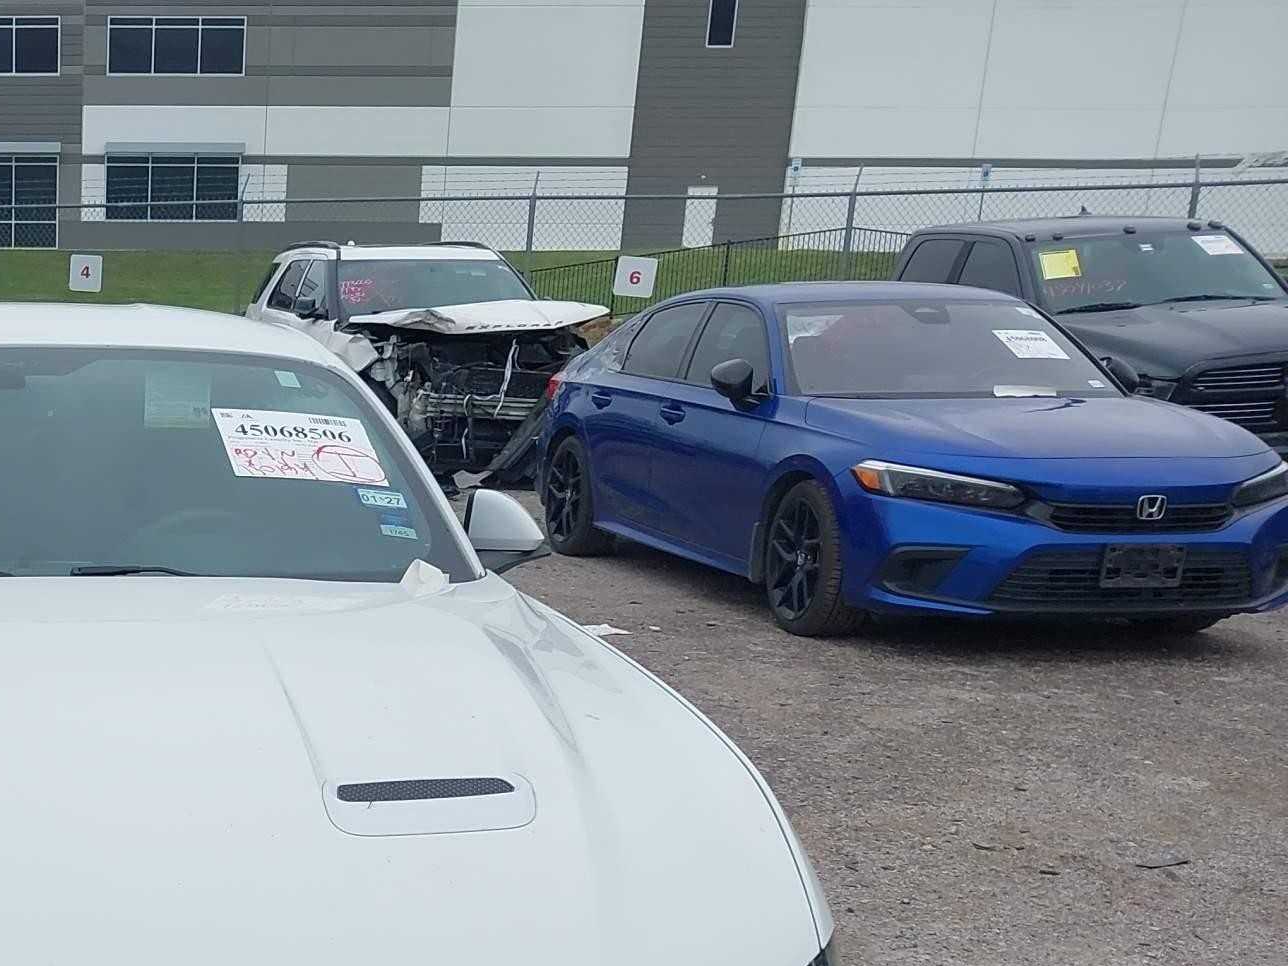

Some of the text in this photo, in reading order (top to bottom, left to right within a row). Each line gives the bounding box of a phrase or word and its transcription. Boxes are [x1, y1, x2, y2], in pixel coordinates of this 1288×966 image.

[80, 265, 91, 279] 4
[629, 270, 642, 285] 6
[234, 423, 352, 443] 45068506
